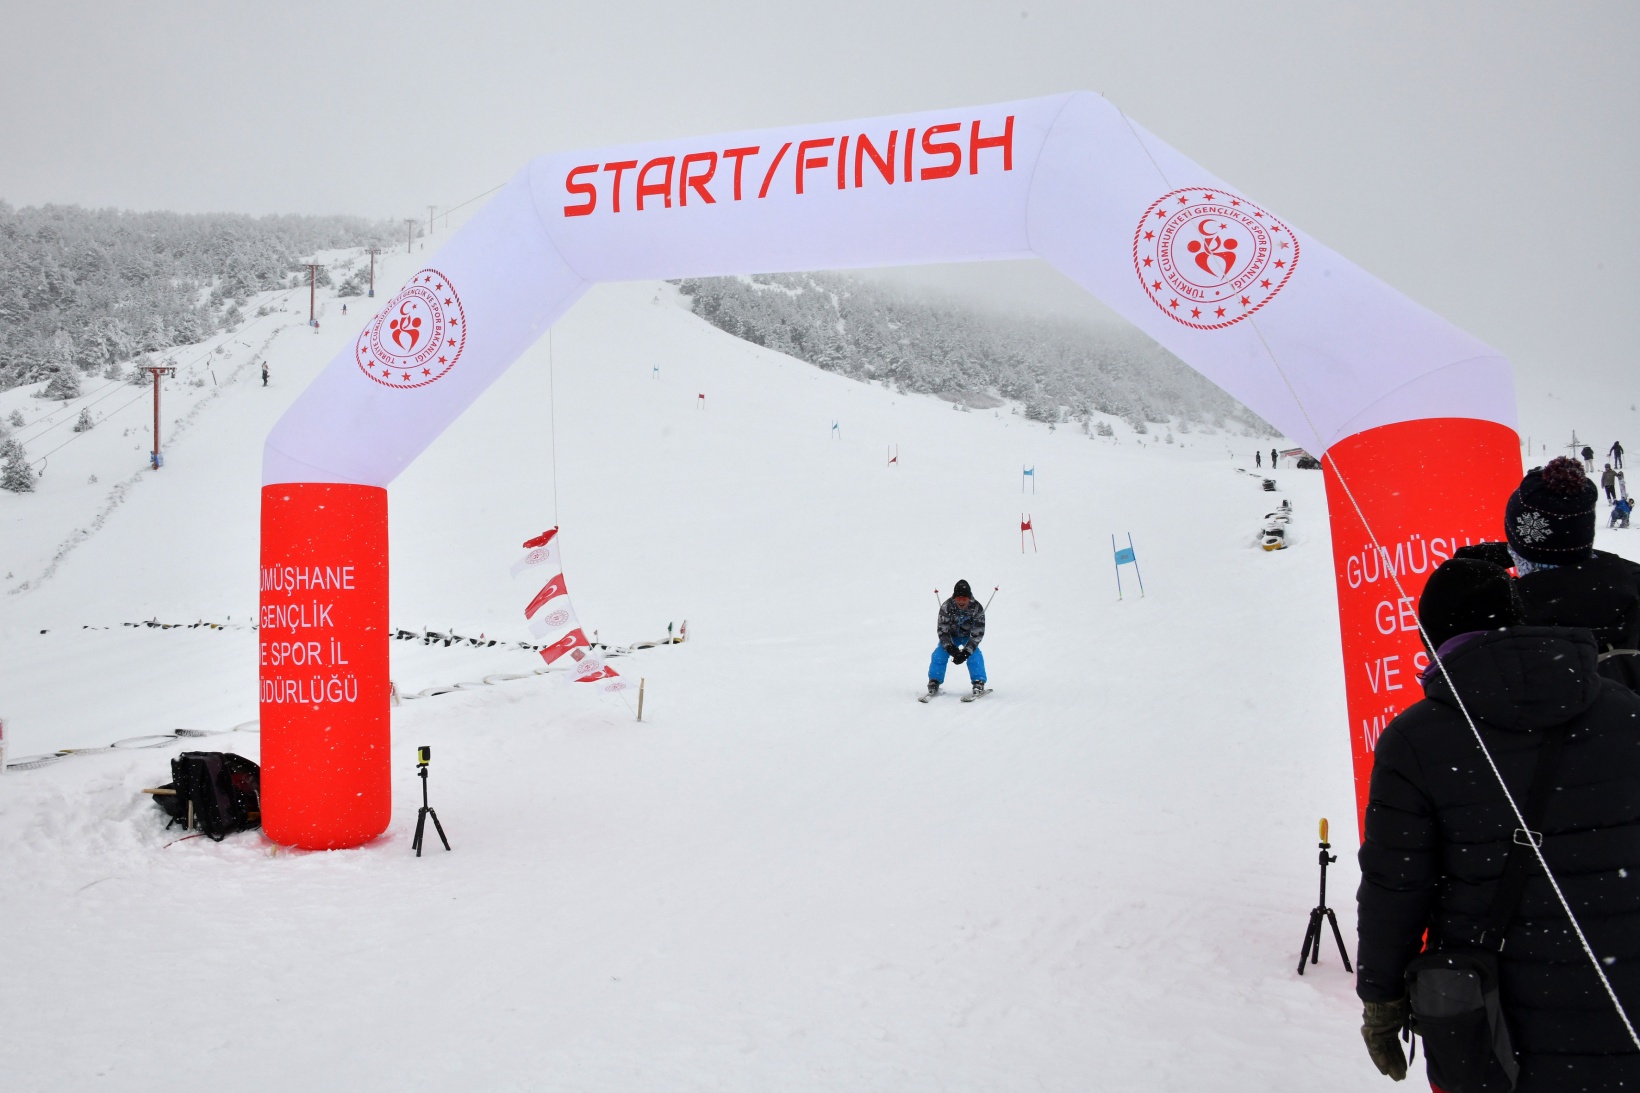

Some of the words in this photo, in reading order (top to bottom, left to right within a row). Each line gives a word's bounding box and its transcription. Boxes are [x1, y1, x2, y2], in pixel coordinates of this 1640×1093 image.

[564, 116, 1015, 217] START/FINISH
[1194, 206, 1240, 219] GENÇLİK
[1241, 216, 1254, 226] VE
[1161, 209, 1192, 272] CUMHURİYETİ
[1251, 225, 1267, 246] SPOR
[1232, 247, 1267, 291] BAKANLIĞI
[1168, 270, 1205, 299] TÜRKİYE
[426, 294, 434, 303] VE
[431, 302, 442, 324] SPOR
[260, 563, 355, 596] ÜMÜŞHANE
[261, 600, 334, 634] GENÇLİK
[271, 641, 322, 666] SPOR
[330, 637, 349, 665] İL
[259, 674, 358, 704] ÜDÜRLÜĞÜ
[1365, 655, 1403, 694] VE
